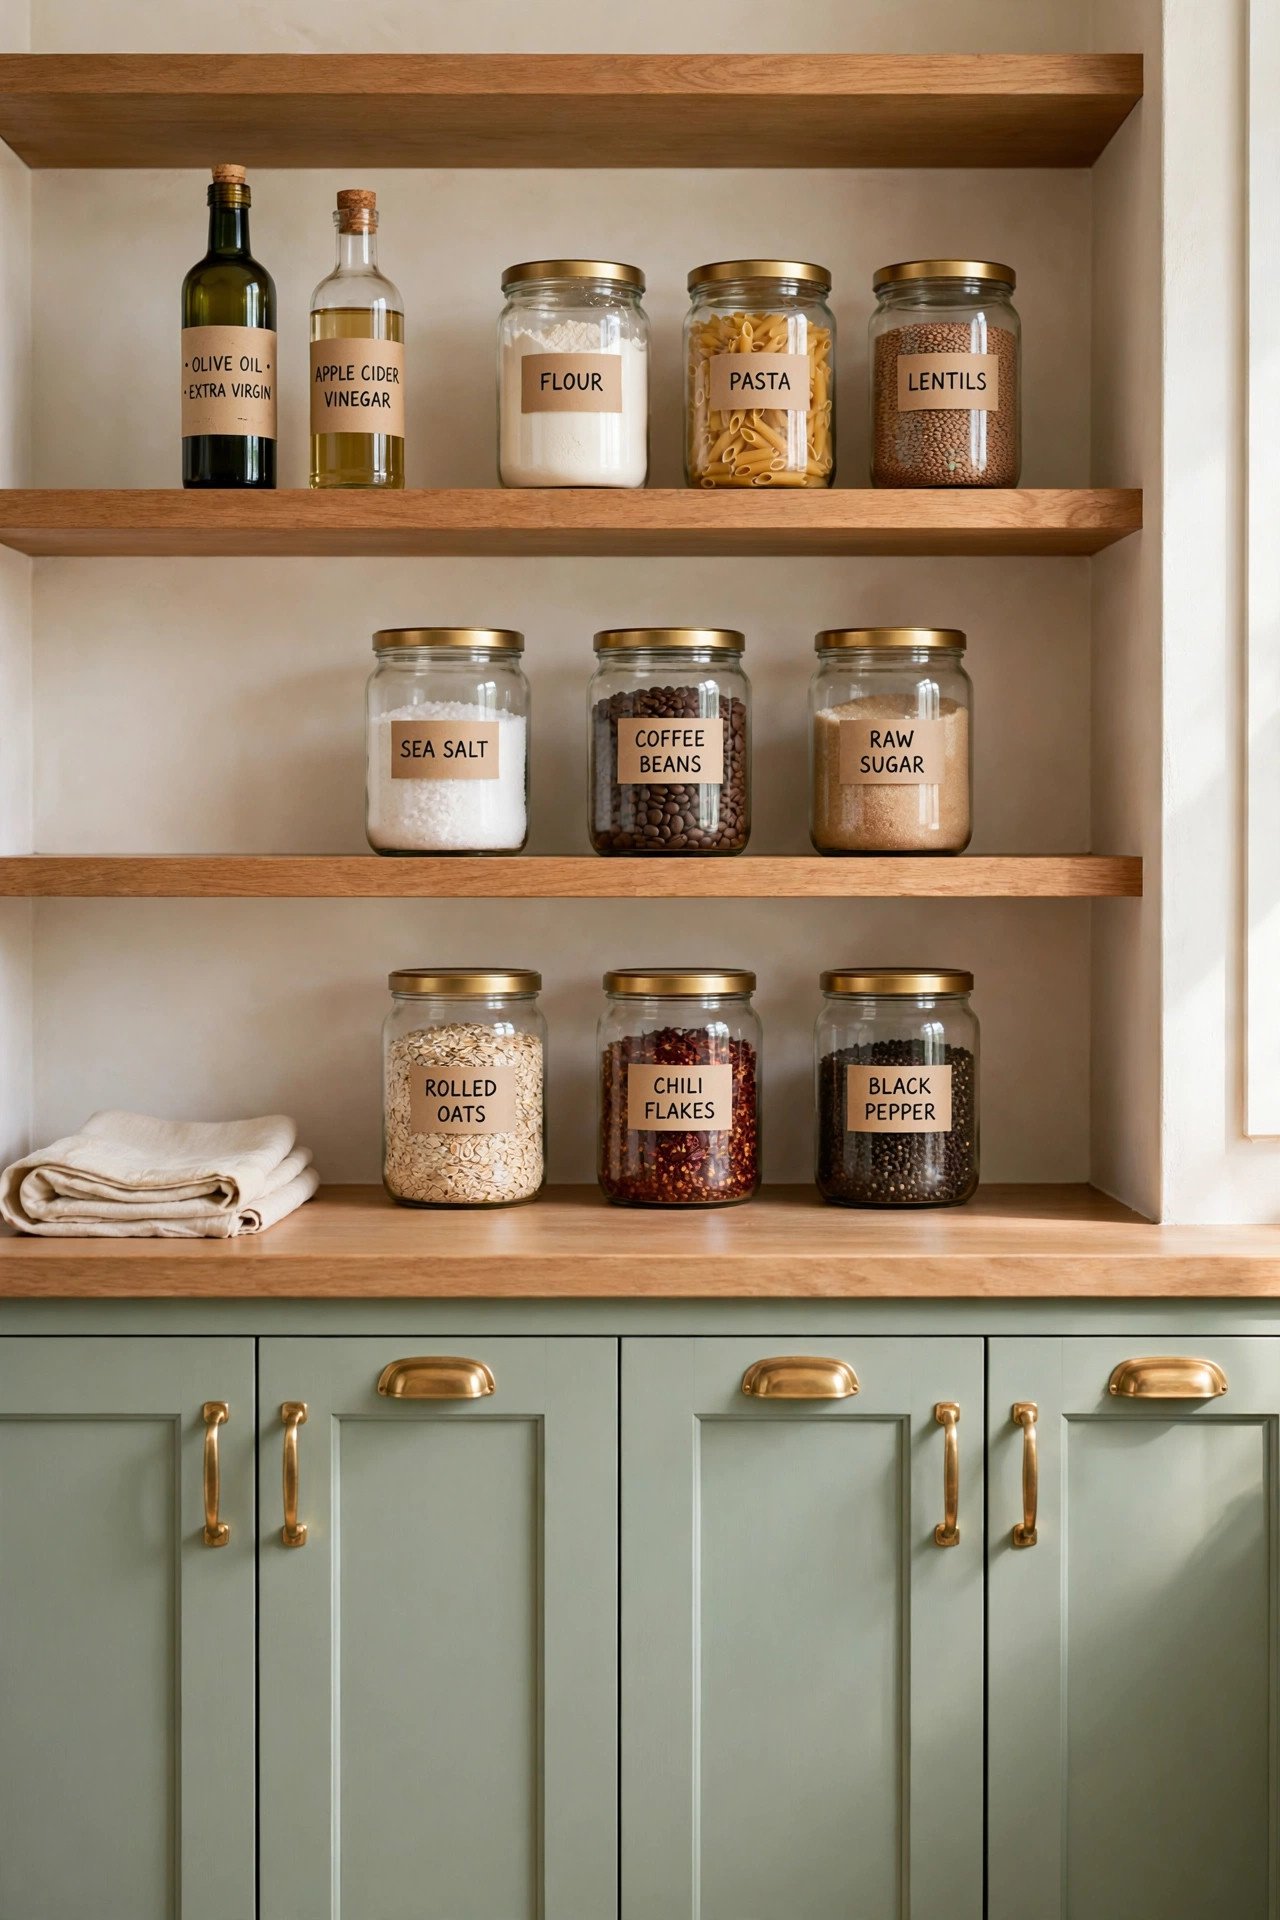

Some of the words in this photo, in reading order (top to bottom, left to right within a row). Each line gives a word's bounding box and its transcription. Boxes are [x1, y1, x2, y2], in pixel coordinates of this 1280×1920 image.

[192, 356, 232, 372] OLIVE
[240, 356, 262, 373] OIL
[315, 365, 355, 383] APPLE
[362, 365, 399, 383] CIDER
[541, 372, 603, 391] FLOUR
[731, 372, 790, 390] PASTA
[909, 372, 986, 391] LENTILS
[189, 383, 226, 399] EXTRA
[232, 384, 271, 400] VIRGIN
[324, 391, 391, 408] VINEGAR
[635, 730, 704, 747] COFFEE
[871, 730, 914, 748] RAW
[400, 740, 435, 758] SEA
[443, 741, 488, 758] SALT
[640, 755, 701, 773] BEANS
[860, 756, 924, 773] SUGAR
[426, 1079, 496, 1097] ROLLED
[654, 1077, 701, 1094] CHILI
[869, 1077, 931, 1095] BLACK
[438, 1106, 485, 1122] OATS
[645, 1102, 714, 1119] FLAKES
[866, 1103, 935, 1120] PEPPER
